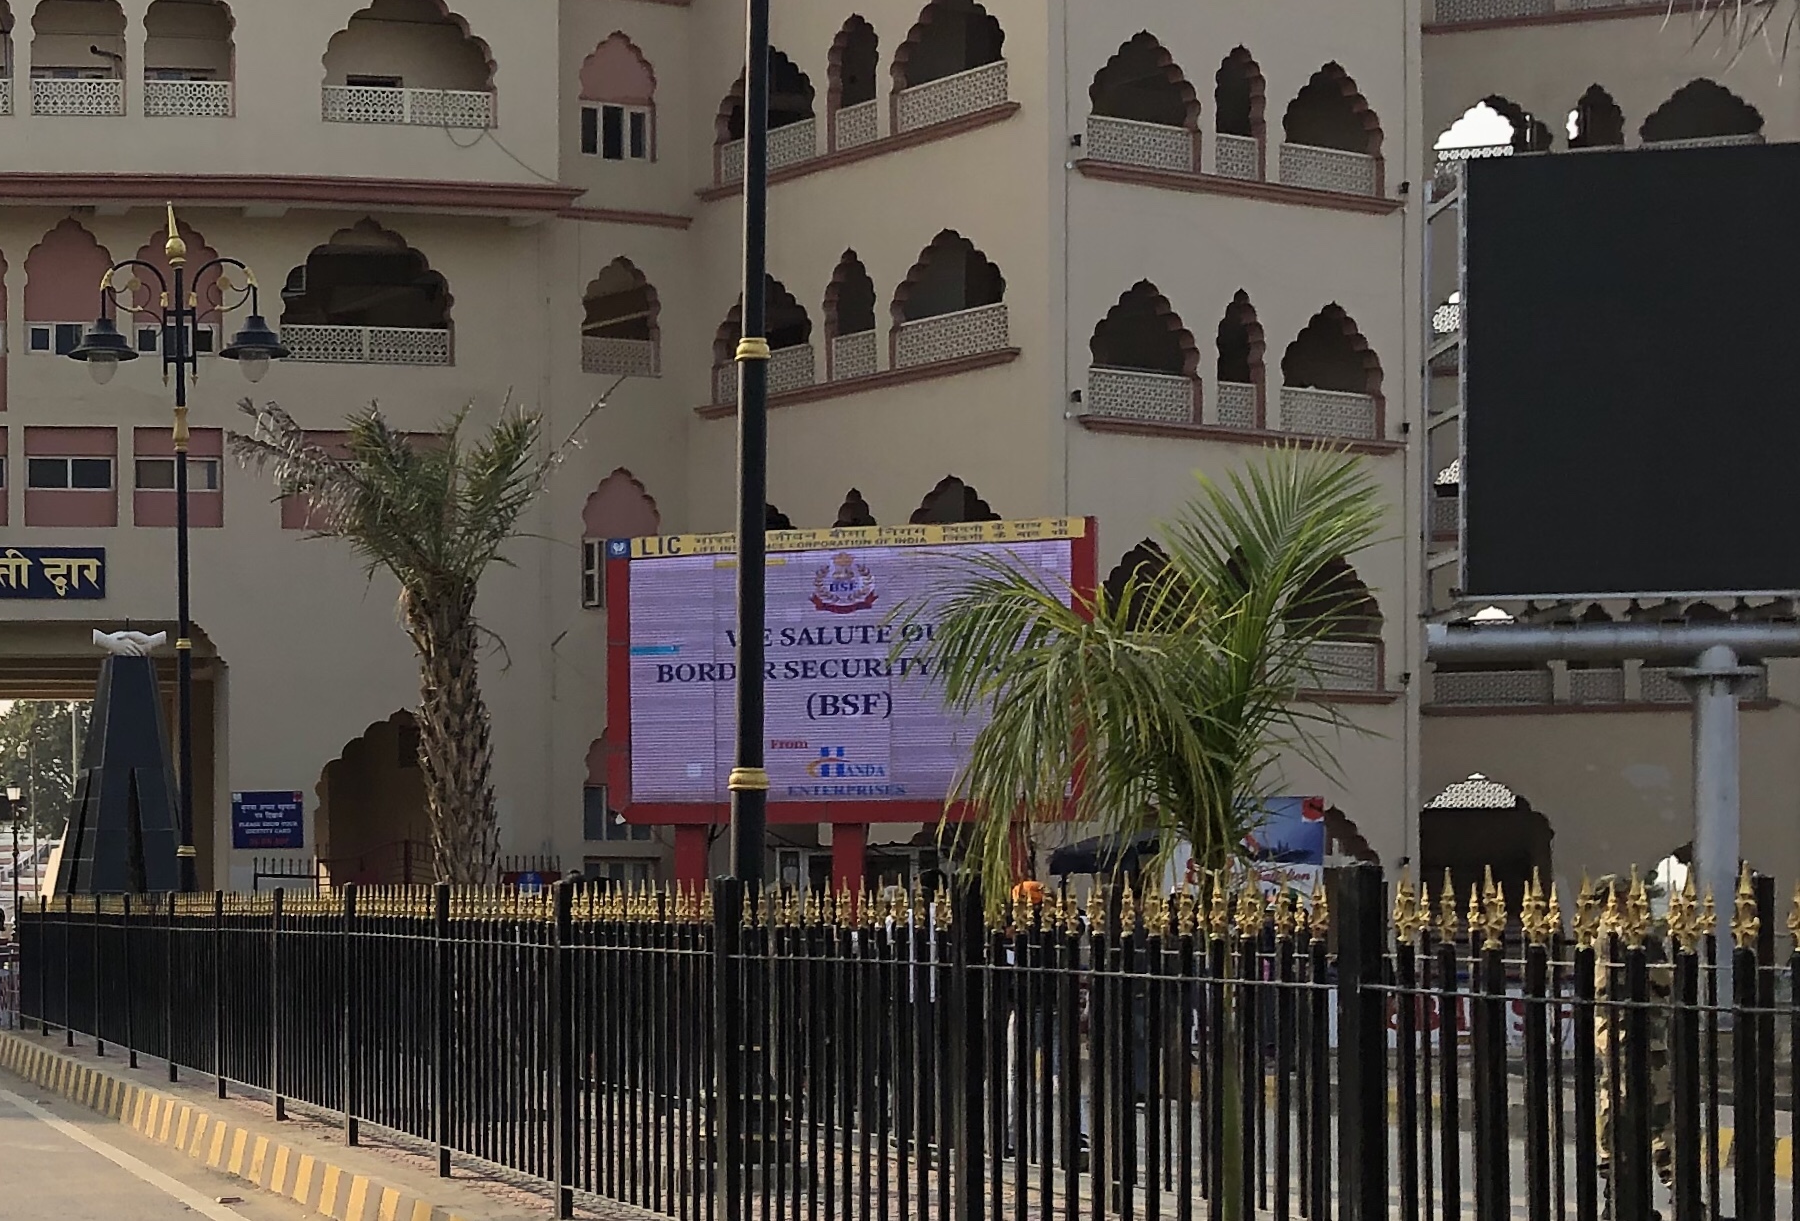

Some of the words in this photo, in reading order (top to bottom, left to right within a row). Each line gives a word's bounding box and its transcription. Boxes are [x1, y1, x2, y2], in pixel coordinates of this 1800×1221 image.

[641, 536, 681, 556] LIC
[894, 536, 928, 545] INDIA
[39, 556, 103, 597] द्वार
[780, 624, 893, 646] SALUTE
[656, 662, 777, 684] BORDR
[783, 657, 935, 679] SECURITY
[806, 691, 894, 720] (BSF)
[770, 739, 809, 750] From
[787, 784, 908, 797] ENTERPRISES
